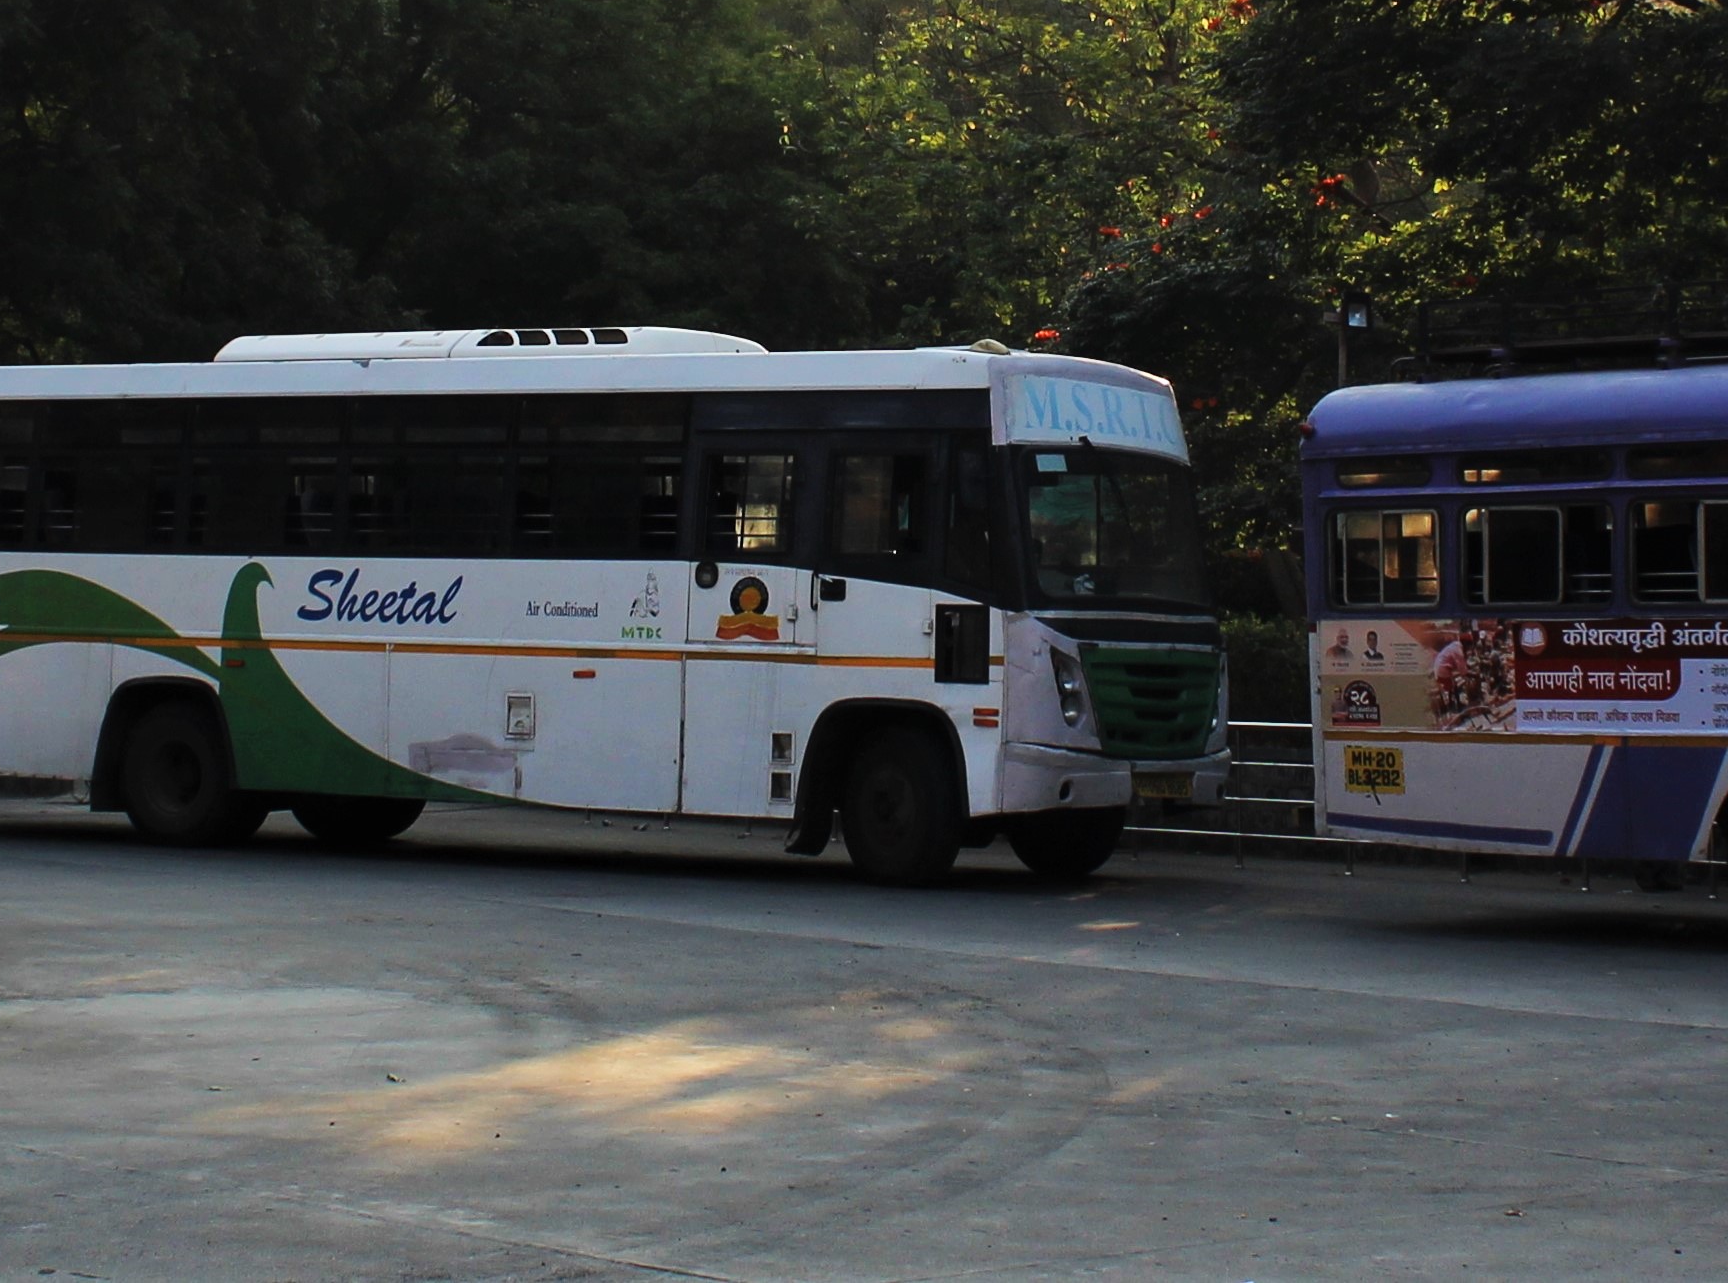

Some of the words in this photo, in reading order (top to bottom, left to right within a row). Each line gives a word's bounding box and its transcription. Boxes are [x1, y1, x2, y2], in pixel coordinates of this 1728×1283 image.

[297, 567, 464, 625] Sheetal
[525, 601, 540, 617] Air
[543, 601, 599, 618] Conditioned
[621, 626, 663, 640] MTDC
[1562, 622, 1667, 653] कौशल्यवृद्धी
[1525, 664, 1584, 694] आपणही
[1587, 671, 1616, 690] नाव
[1618, 664, 1672, 693] नोंदवा!
